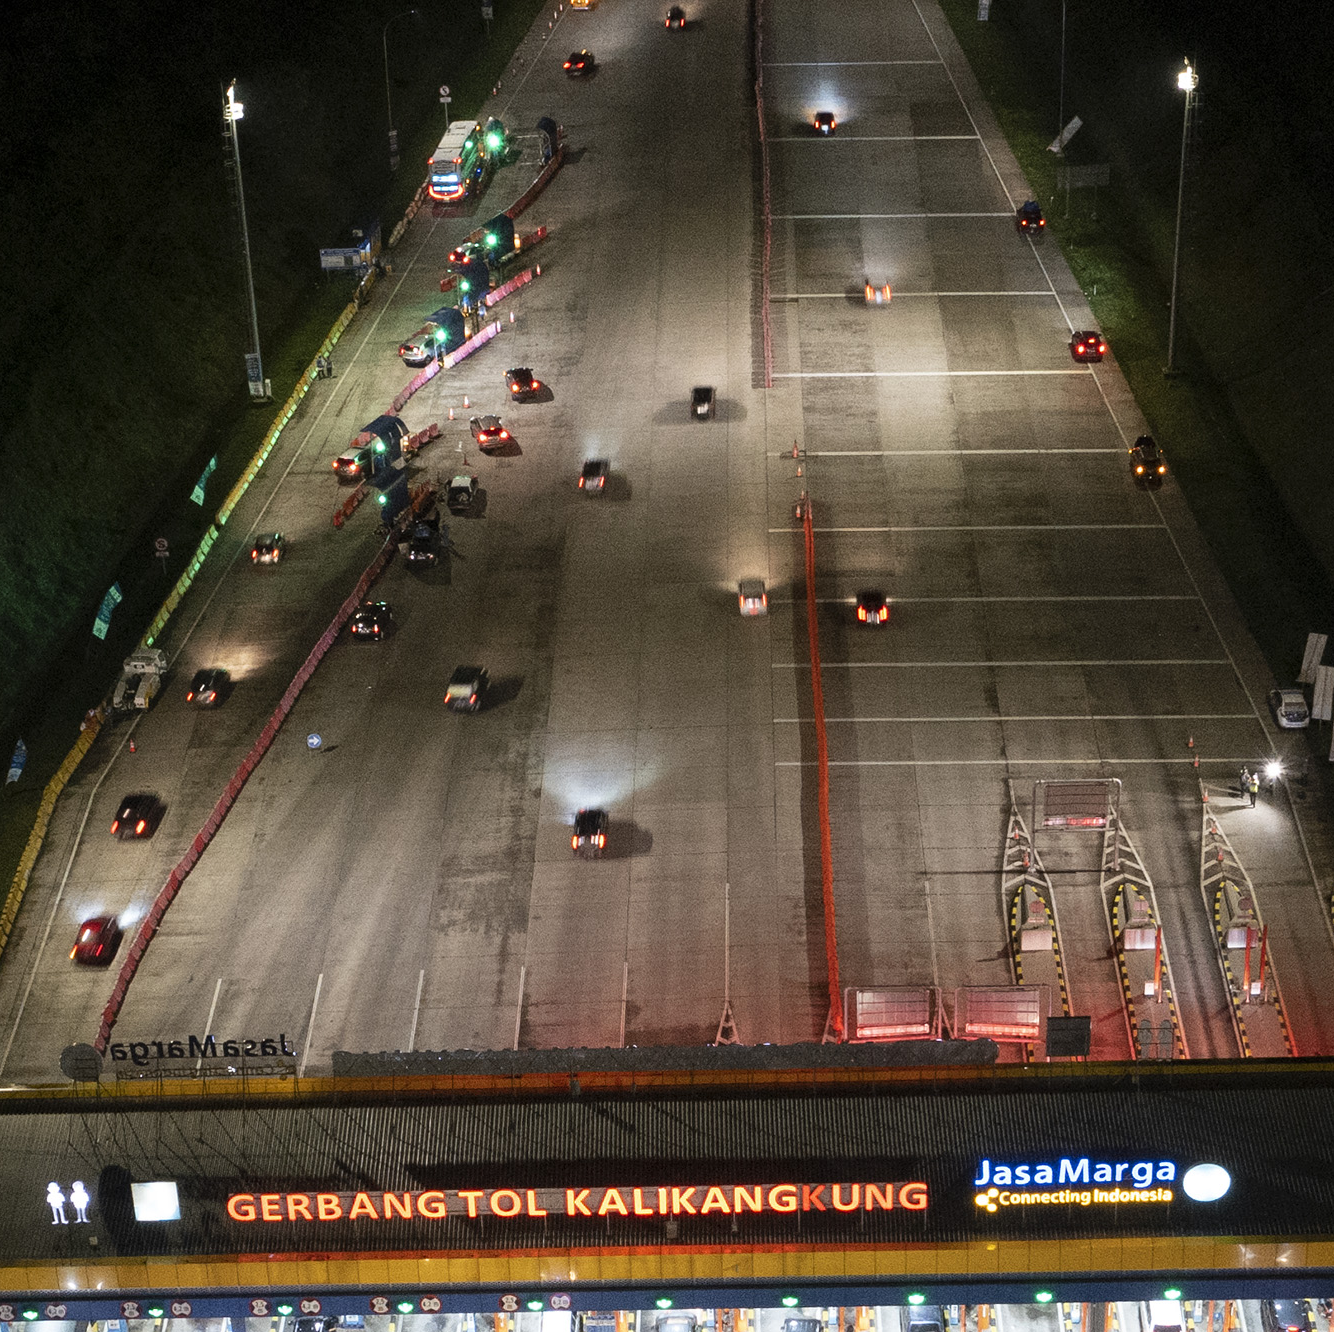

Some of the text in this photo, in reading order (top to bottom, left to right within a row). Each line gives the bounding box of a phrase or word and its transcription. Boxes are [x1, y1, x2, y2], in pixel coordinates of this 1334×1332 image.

[975, 1158, 1176, 1188] JasaMarga
[227, 1182, 928, 1222] GERBANG TOL KALIKANGKUNG
[999, 1187, 1173, 1206] Connecting Indonesia
